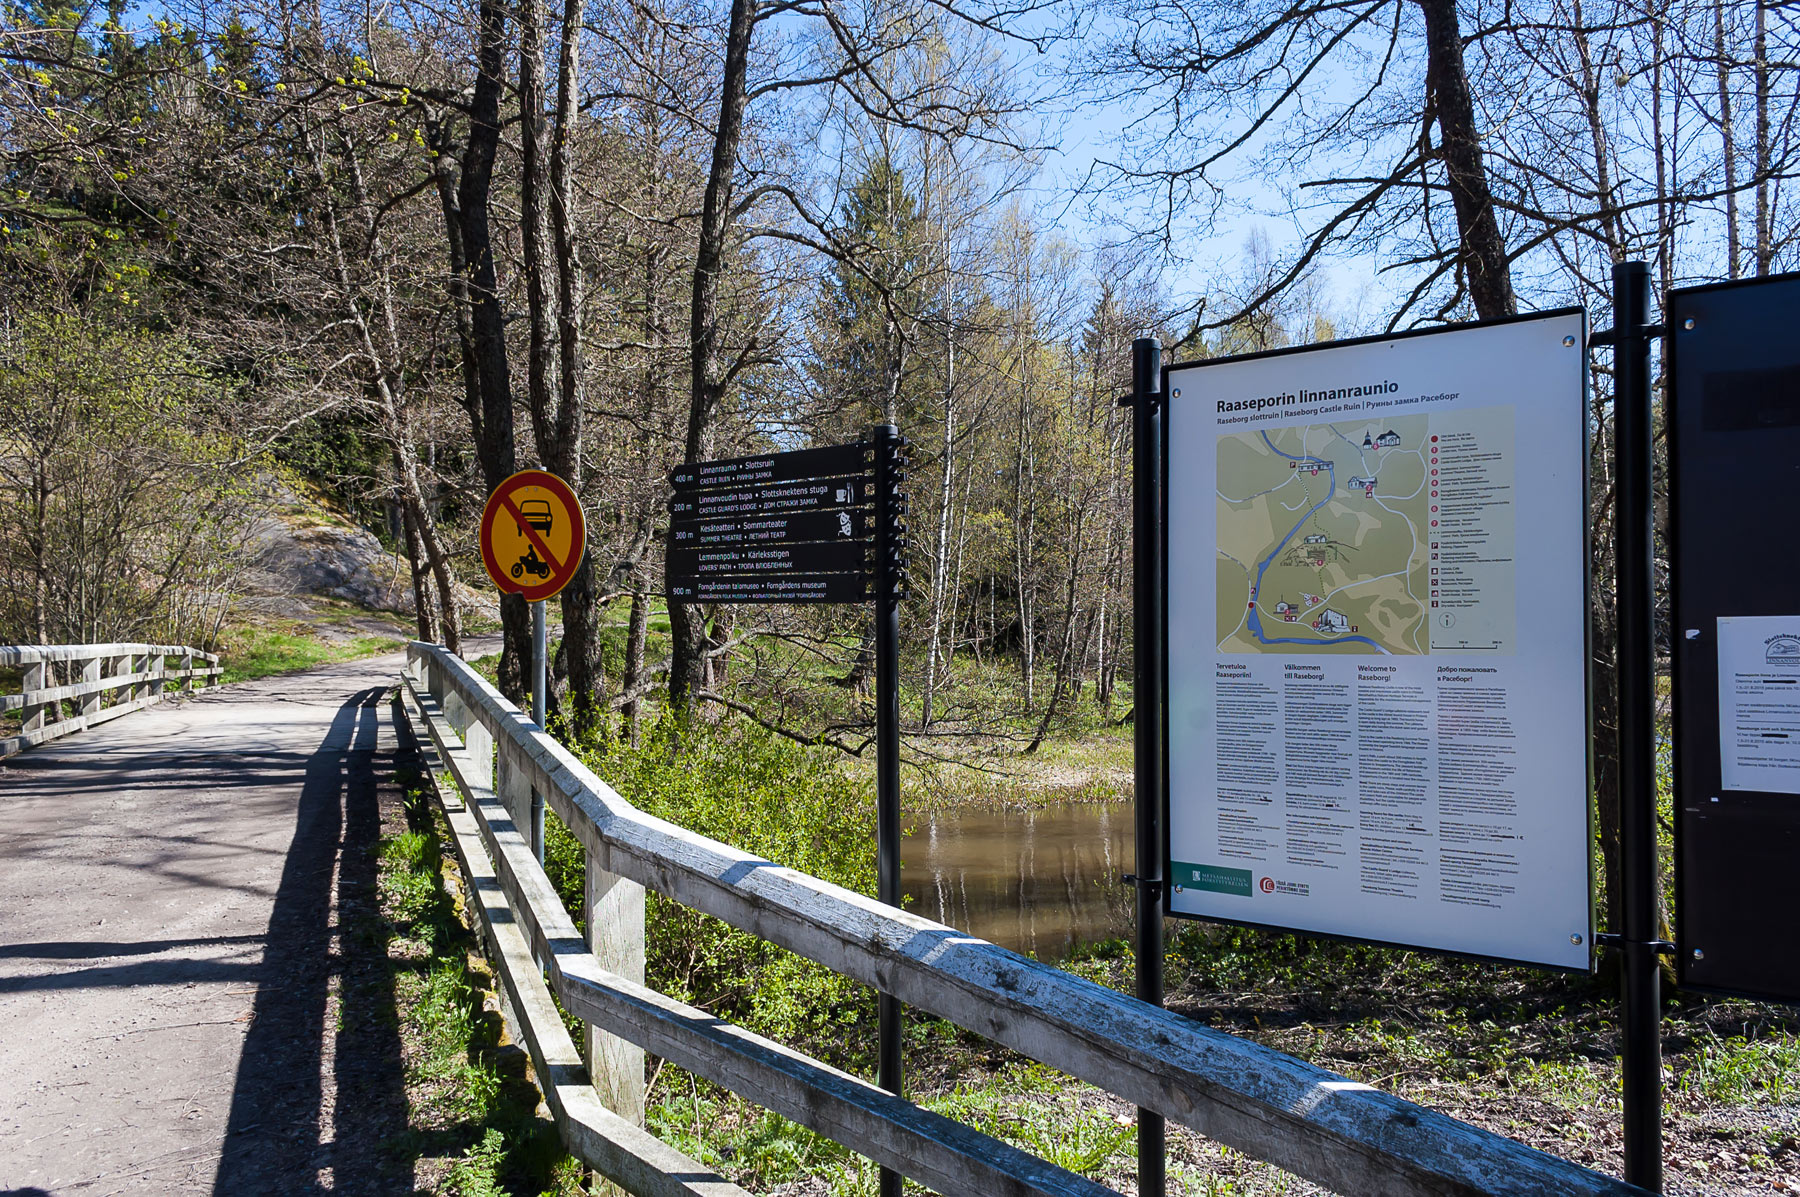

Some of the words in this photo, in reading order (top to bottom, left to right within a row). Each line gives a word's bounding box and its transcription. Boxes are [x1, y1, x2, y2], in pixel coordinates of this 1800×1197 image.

[1216, 392, 1296, 414] Raaseporin
[1299, 380, 1399, 404] linnanraunio
[1366, 400, 1393, 412] Руины
[1394, 397, 1419, 406] замка
[1420, 391, 1461, 405] Расеборг
[1216, 414, 1248, 425] Raseborg
[1249, 411, 1280, 422] slottruin
[1284, 406, 1318, 418] Raseborg
[1319, 404, 1342, 415] Castle
[1343, 403, 1361, 412] Ruin
[700, 464, 737, 476] Linnanraunio
[745, 458, 774, 470] Slottsruin
[675, 474, 686, 482] 400
[700, 476, 717, 484] CASTLE
[755, 470, 773, 480] ЗАМКА
[698, 492, 738, 504] Linnanvoudin
[738, 492, 753, 503] tupa
[760, 485, 808, 499] Slottsknektens
[808, 484, 828, 497] stuga
[674, 503, 686, 511] 200
[698, 505, 716, 514] CASTLE
[740, 502, 757, 511] LODGE
[763, 501, 776, 510] ДОМ
[776, 499, 799, 509] СТРАЖИ
[800, 497, 818, 506] ЗАМКА
[700, 522, 736, 532] Kesäteatteri
[743, 519, 788, 530] Sommarteater
[700, 534, 720, 543] SUMMER
[721, 534, 743, 542] THEATRE
[769, 530, 786, 540] ТЕАТР
[698, 550, 740, 562] Lemmenpolku
[748, 549, 790, 561] Kärleksstigen
[698, 562, 720, 572] LOVERS'
[720, 562, 732, 570] PATH
[738, 562, 755, 570] ТРОПА
[756, 560, 793, 570] ВЛЮБЛЕННЫХ
[766, 580, 800, 590] Forngårdens
[672, 587, 684, 595] 900
[1357, 664, 1388, 672] Welcome
[1436, 666, 1458, 674] Добро
[1294, 673, 1325, 682] Raseborg!
[1357, 674, 1391, 682] Raseborg!
[1442, 676, 1473, 684] Расеборг!
